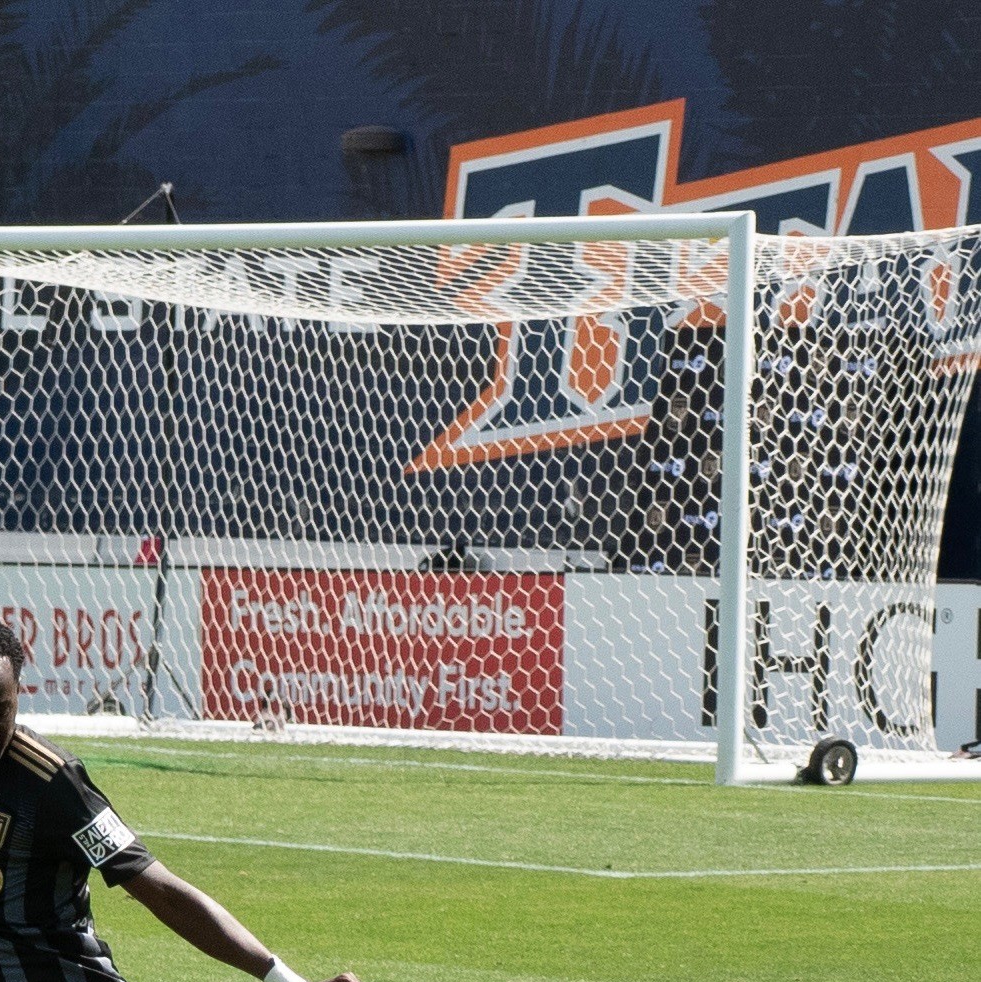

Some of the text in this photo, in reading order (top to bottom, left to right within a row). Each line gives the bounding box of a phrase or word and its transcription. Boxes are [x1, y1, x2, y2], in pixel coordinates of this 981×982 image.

[231, 590, 534, 639] Fresh. Affordable.
[229, 659, 520, 718] Community First.
